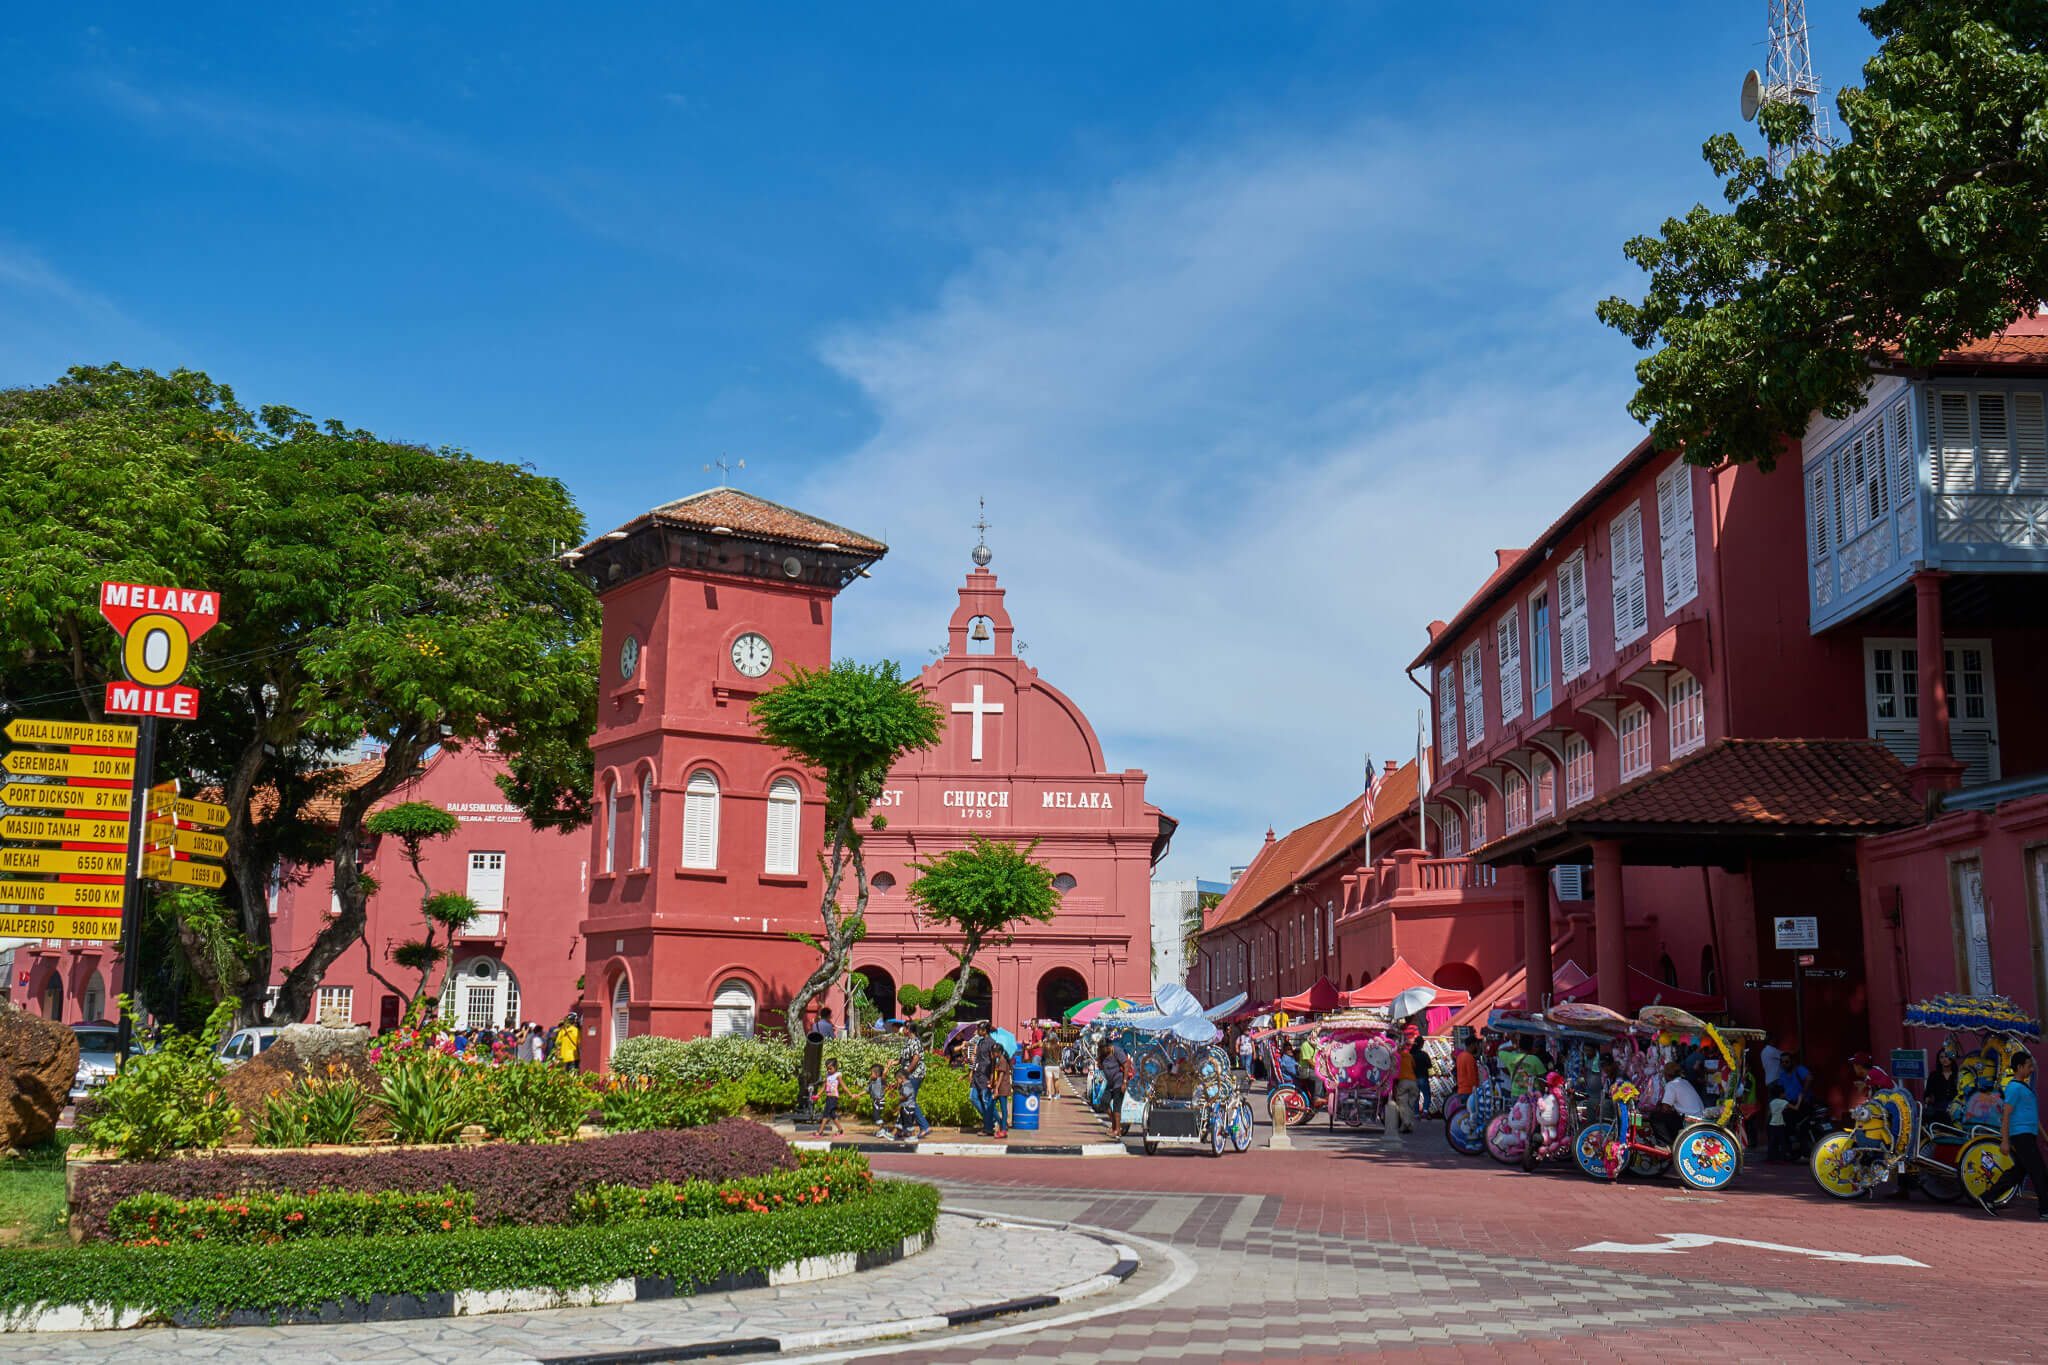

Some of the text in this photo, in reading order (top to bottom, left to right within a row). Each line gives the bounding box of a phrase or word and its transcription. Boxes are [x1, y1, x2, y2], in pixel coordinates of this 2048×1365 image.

[105, 584, 215, 615] MELAKA
[122, 613, 191, 689] 0
[112, 688, 193, 714] MILE
[15, 724, 133, 744] KUALA LUMPUR 168 KM
[12, 756, 130, 775] SEREMBAN 100 KM
[9, 788, 127, 807] PORT DICKSON 87 KM
[943, 790, 1009, 808] CHURCH
[1042, 791, 1113, 809] MELAKA
[216, 809, 226, 822] KM
[961, 809, 992, 818] 1753
[6, 820, 125, 839] MASJID TANAH 28 KM
[213, 839, 223, 853] KM
[4, 853, 122, 871] MEKAH 6550 KM
[212, 870, 221, 883] KM
[0, 886, 120, 903] NANJING 5500 KM
[0, 919, 117, 935] VALPERISO 9800 KM
